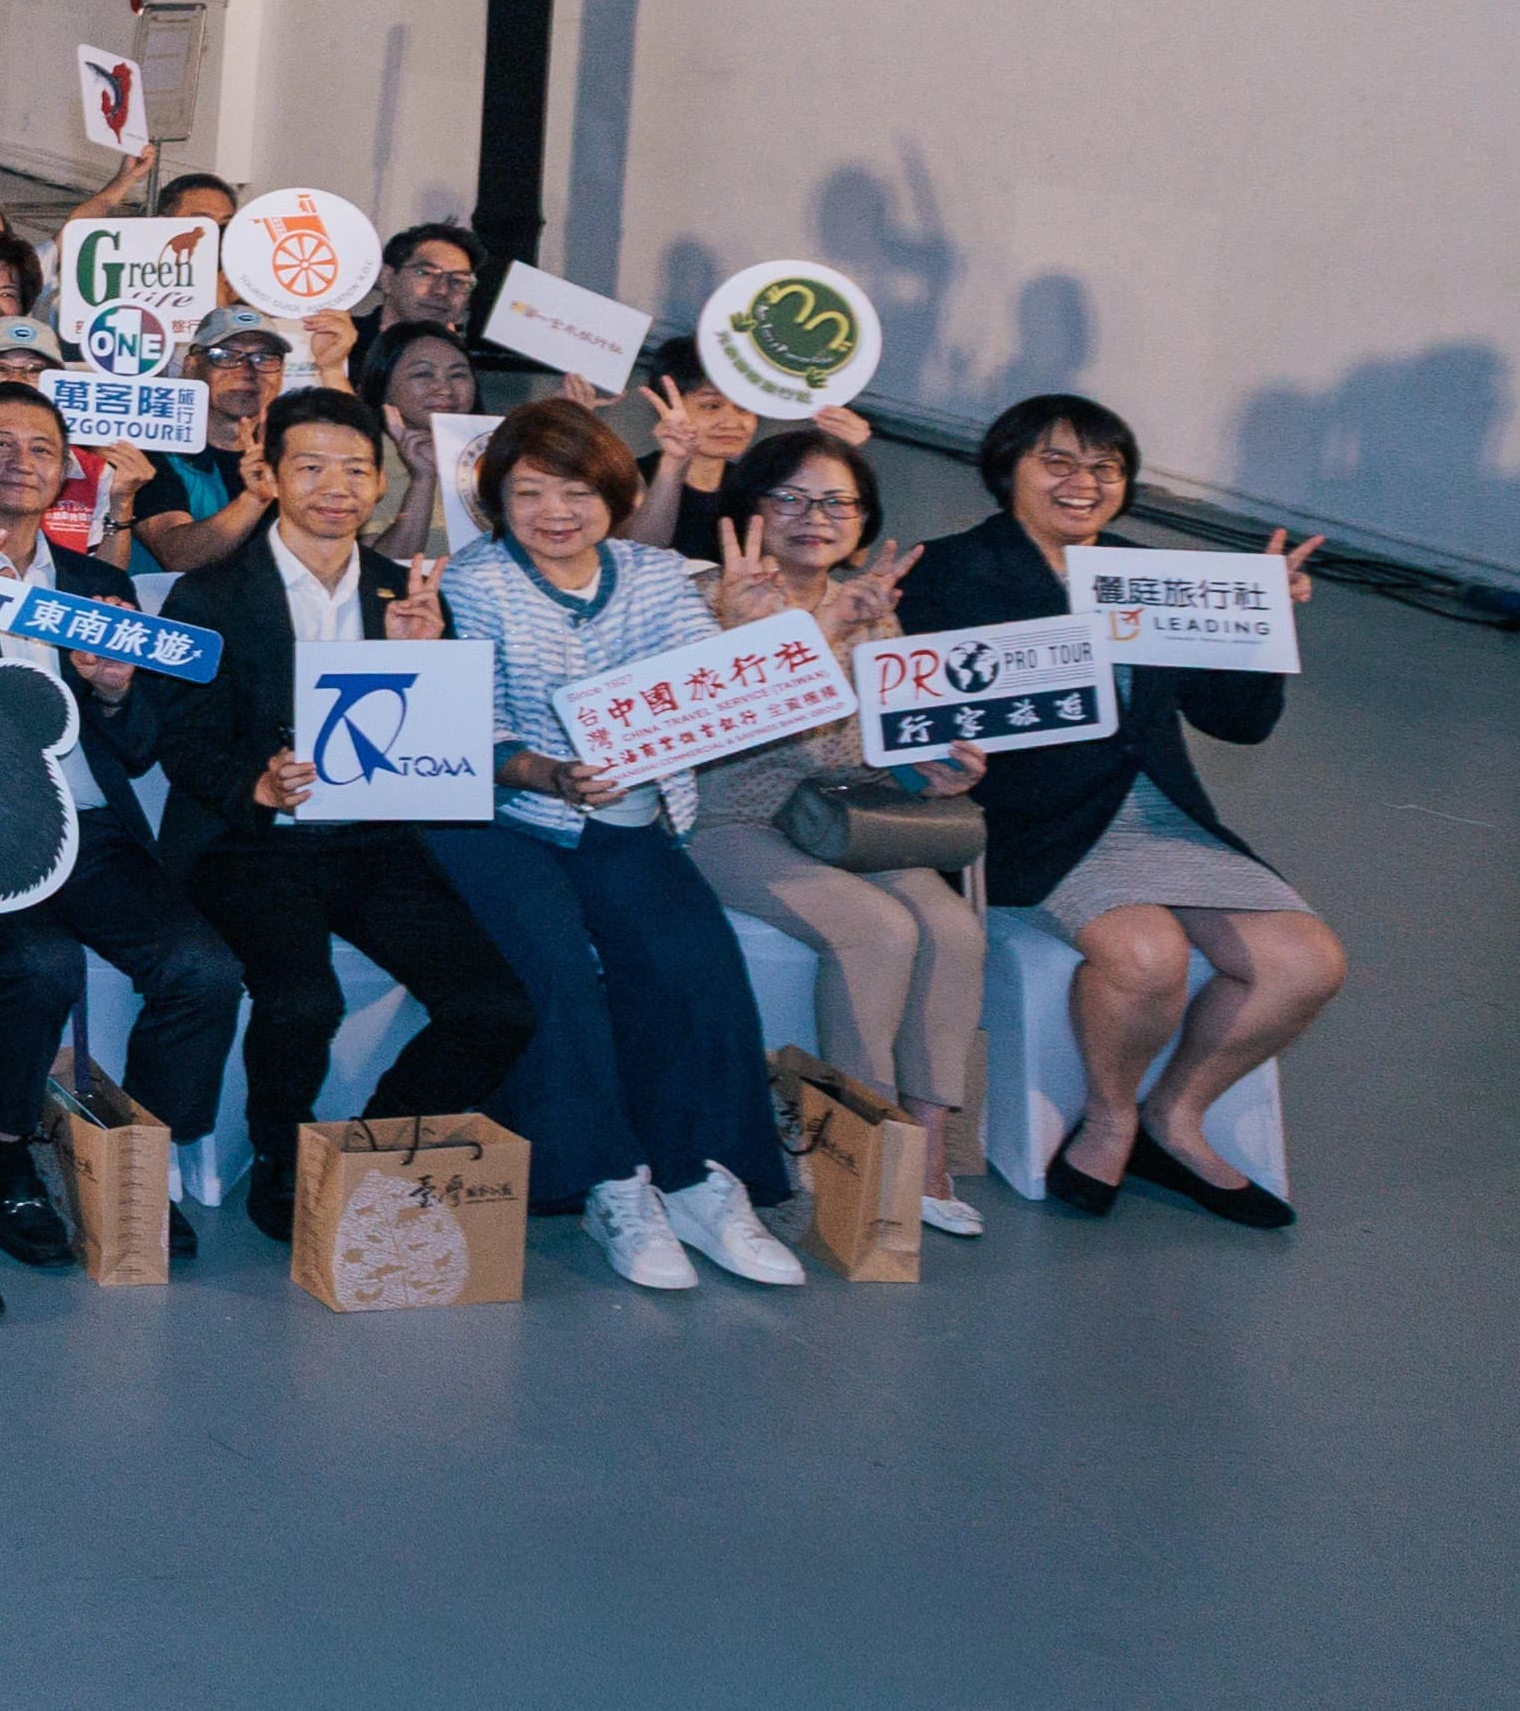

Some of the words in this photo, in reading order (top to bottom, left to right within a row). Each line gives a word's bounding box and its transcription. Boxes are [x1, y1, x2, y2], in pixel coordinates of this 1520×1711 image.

[77, 229, 196, 306] Green
[90, 330, 163, 360] ONE
[54, 379, 176, 419] 萬客隆
[24, 598, 199, 667] 東南旅遊
[1153, 615, 1272, 637] LEADING
[1004, 646, 1038, 671] PRO
[1048, 641, 1095, 666] TOUR
[607, 641, 820, 728] 中國旅行社
[577, 706, 614, 751] 台灣
[622, 725, 661, 742] CHINA
[663, 710, 713, 728] TRAVEL
[716, 689, 769, 712] SERVICE
[398, 755, 477, 777] TQAA
